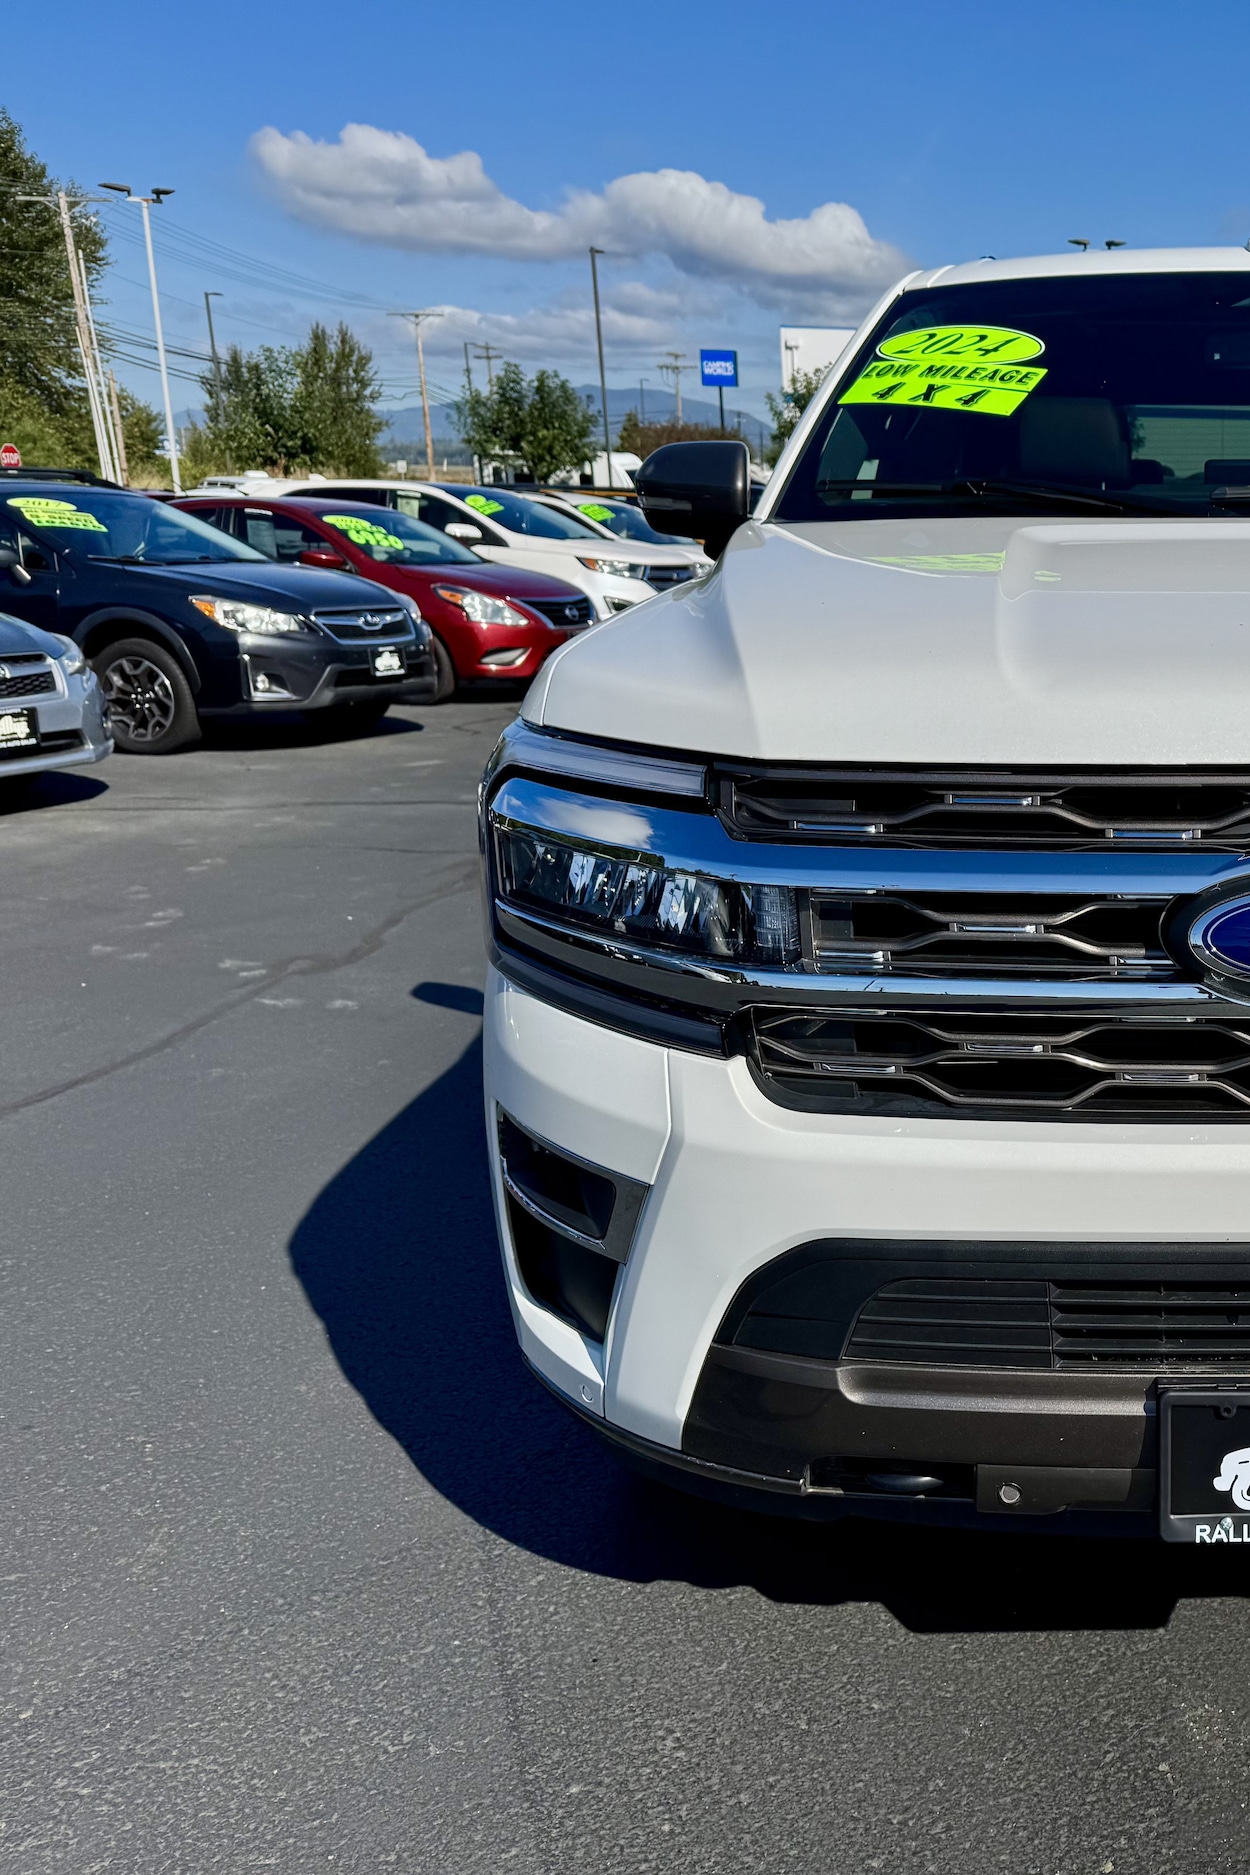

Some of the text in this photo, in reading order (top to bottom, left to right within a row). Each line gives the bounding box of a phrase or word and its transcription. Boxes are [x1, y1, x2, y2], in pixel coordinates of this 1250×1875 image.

[892, 333, 1022, 357] 2024
[704, 367, 734, 375] WORLD
[861, 364, 1040, 386] LOW MILEAGE
[871, 382, 907, 400] 4
[954, 389, 990, 407] 4
[2, 452, 19, 465] STOP
[348, 529, 404, 551] 6950
